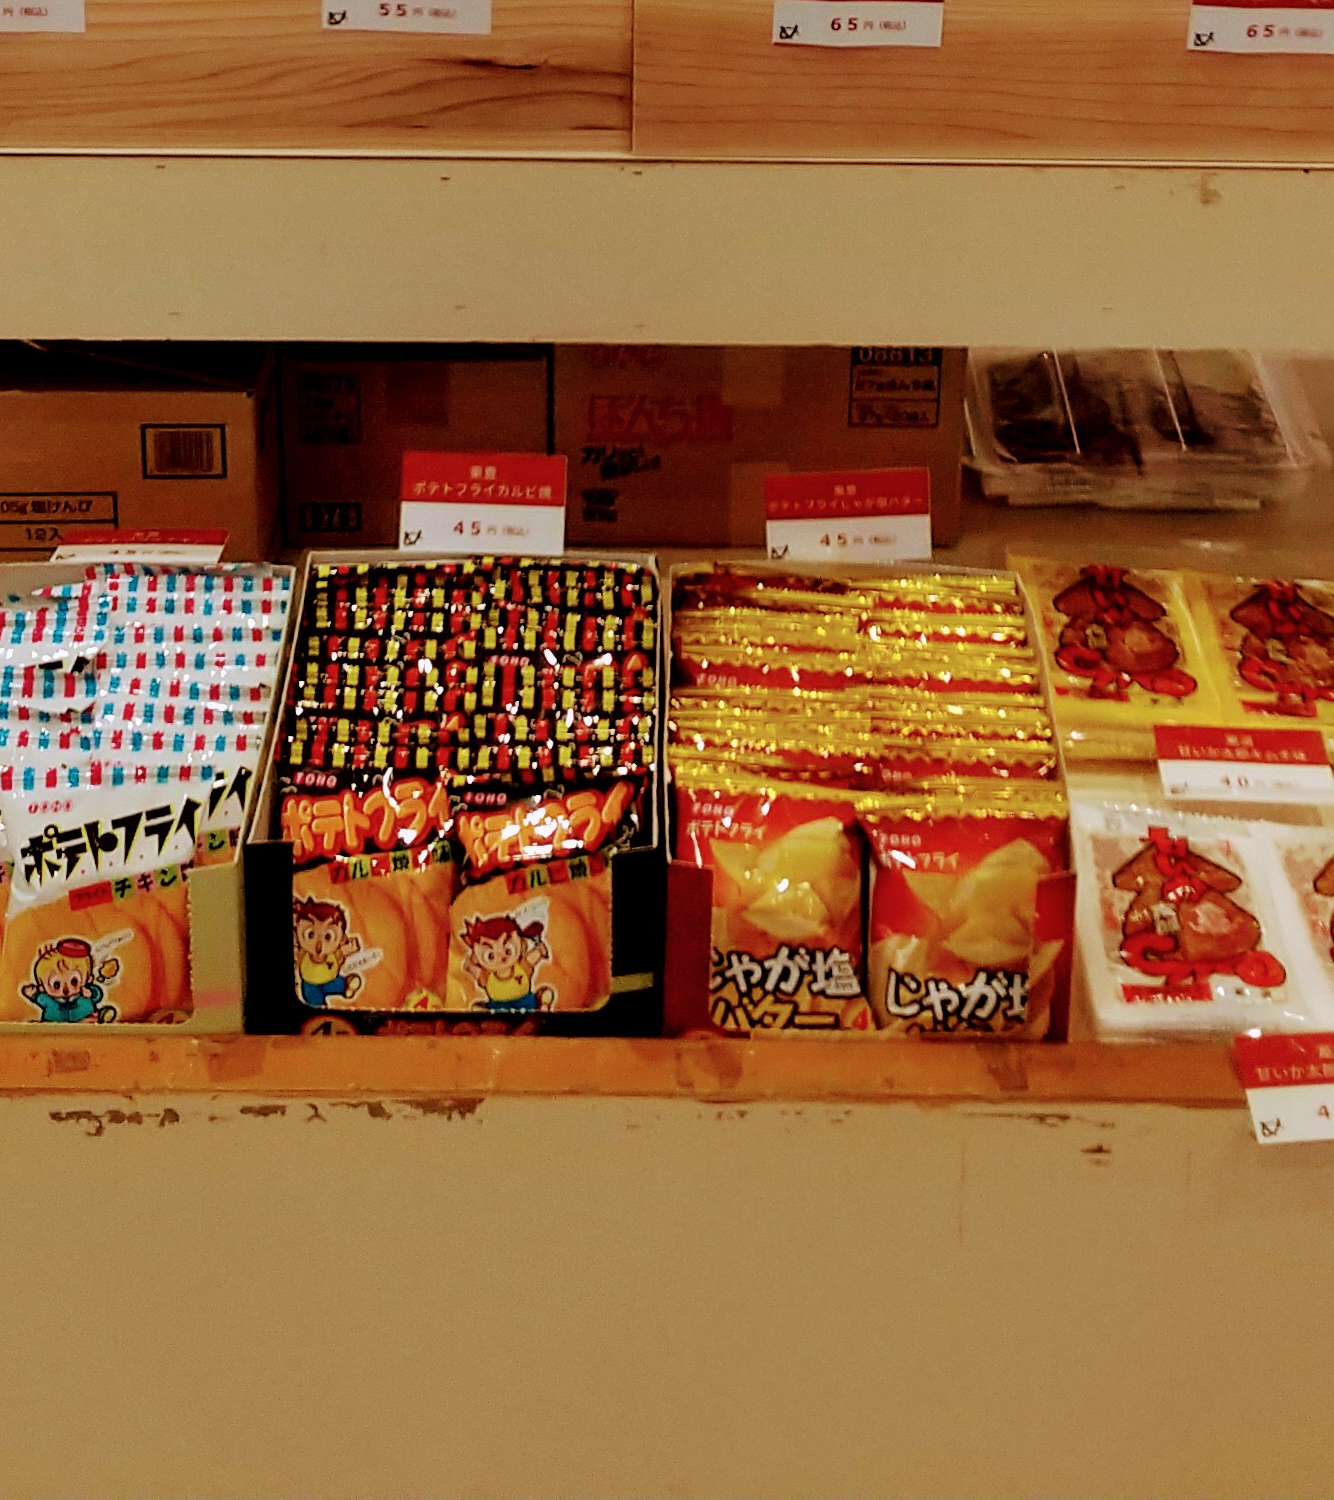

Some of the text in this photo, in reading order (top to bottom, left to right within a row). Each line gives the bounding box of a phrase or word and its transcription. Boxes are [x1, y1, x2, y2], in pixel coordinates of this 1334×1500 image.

[20, 798, 202, 887] ポテトフライ
[281, 780, 451, 861] ポテトフライ
